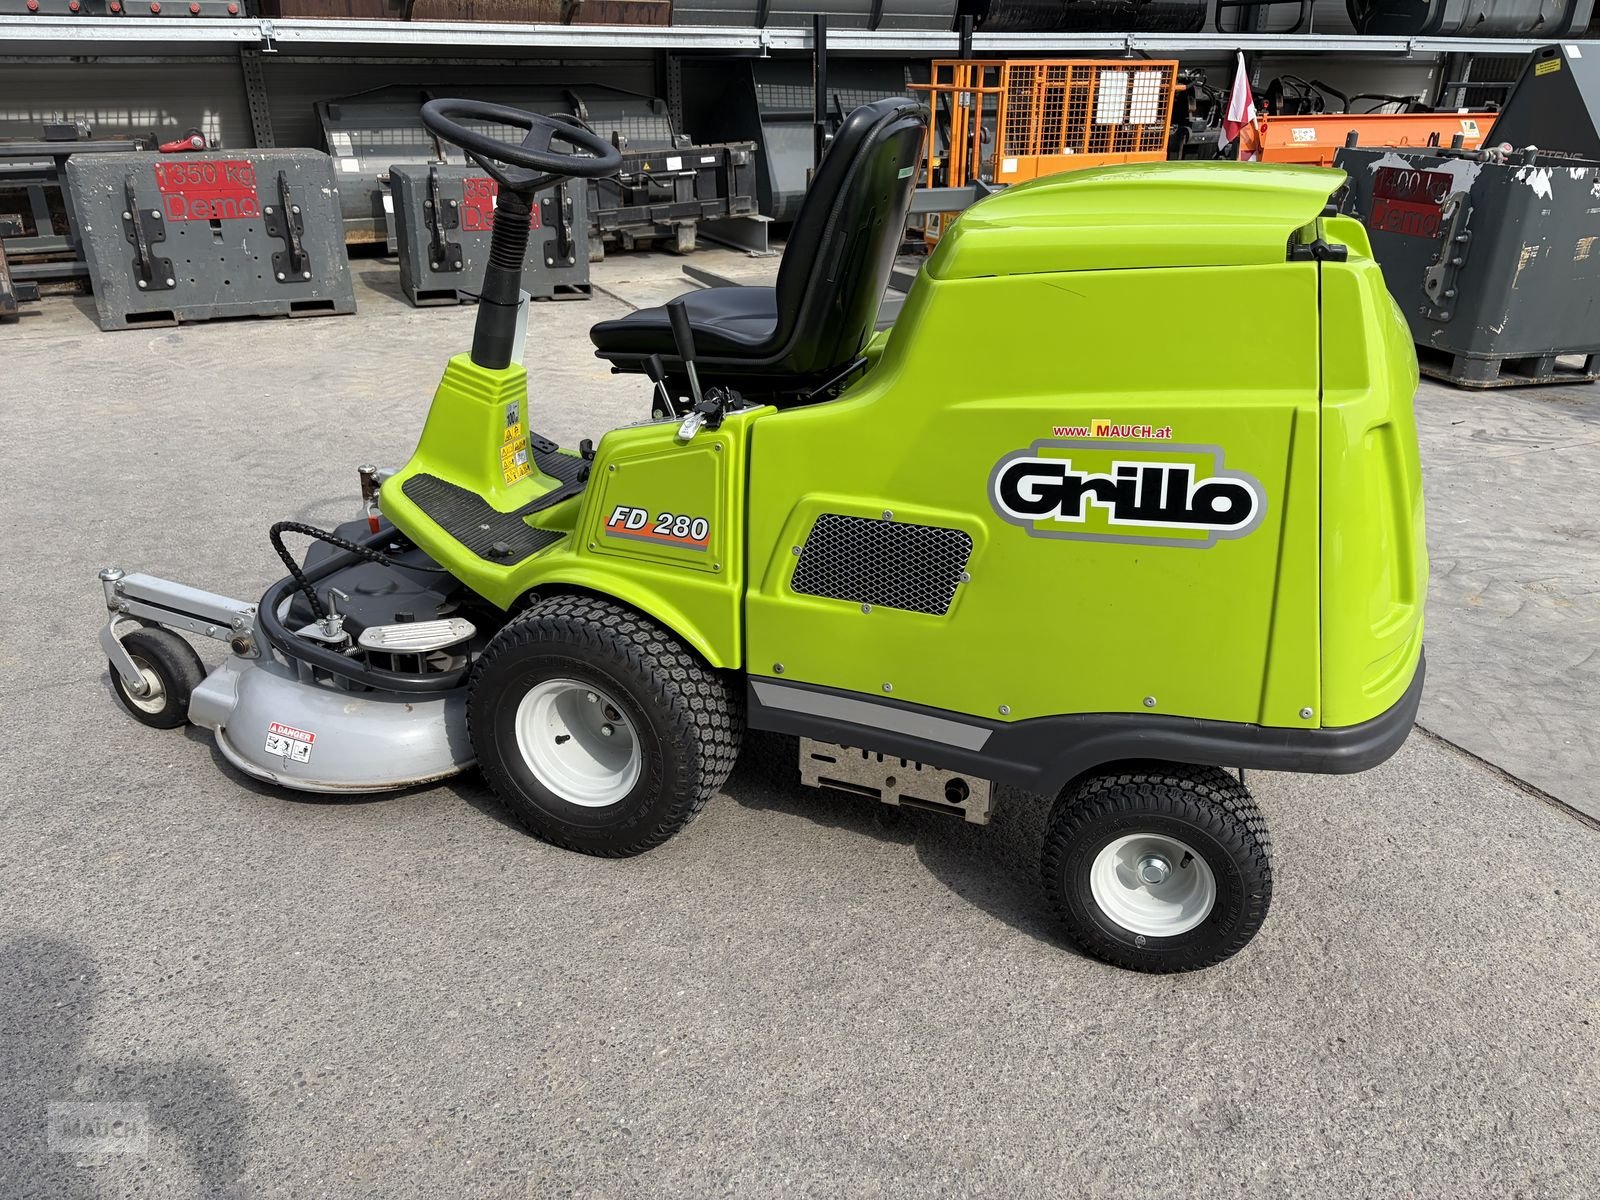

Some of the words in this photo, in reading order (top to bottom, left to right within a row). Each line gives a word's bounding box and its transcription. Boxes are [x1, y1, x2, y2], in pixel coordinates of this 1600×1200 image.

[157, 164, 217, 185] 1350
[224, 162, 255, 188] kg
[1377, 168, 1420, 195] 1400
[1425, 172, 1449, 204] kg
[164, 194, 257, 218] Demo
[1372, 200, 1441, 235] Demo
[998, 462, 1253, 526] Grillo
[607, 505, 649, 530] FD
[652, 512, 709, 541] 280
[277, 725, 312, 742] DANGER
